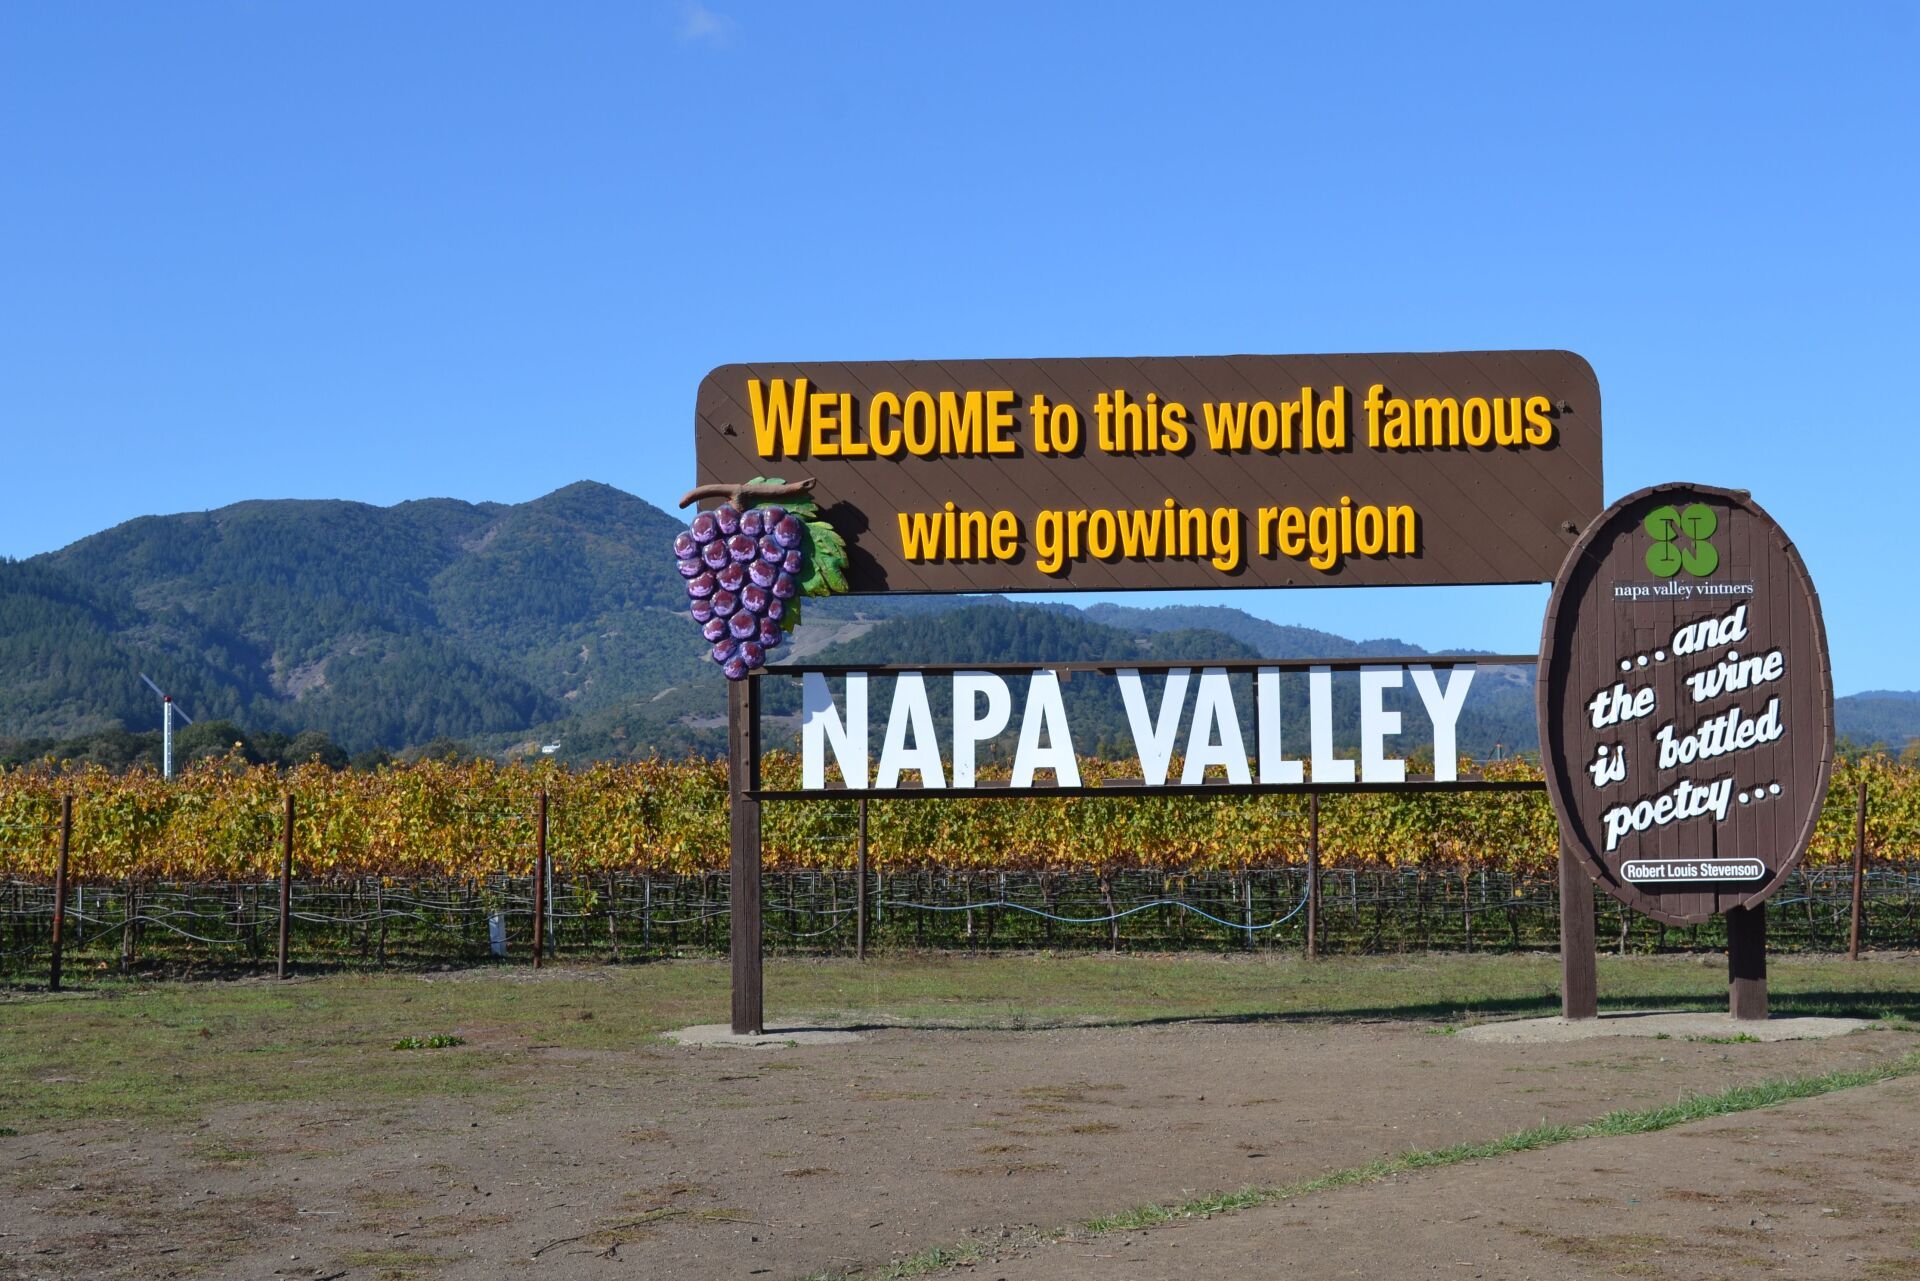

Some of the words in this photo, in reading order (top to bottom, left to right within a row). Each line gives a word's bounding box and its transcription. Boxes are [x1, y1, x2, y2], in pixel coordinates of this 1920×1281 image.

[748, 378, 1015, 457] WELCOME
[1030, 394, 1079, 453] to
[1095, 389, 1188, 452] this
[1203, 386, 1345, 450] world
[1364, 384, 1553, 448] famous
[898, 501, 1017, 560] wine
[1035, 498, 1239, 573] growing
[1258, 496, 1416, 571] region
[1614, 585, 1650, 600] napa
[1653, 581, 1693, 598] valley
[1696, 581, 1754, 595] vintners
[801, 670, 1083, 790] NAPA
[1115, 664, 1477, 786] VALLEY
[1590, 683, 1655, 728] the
[1687, 650, 1783, 702] wine
[1590, 745, 1626, 787] is
[1656, 698, 1783, 769] bottled
[1627, 864, 1665, 878] Robert
[1668, 864, 1697, 877] Louis
[1700, 862, 1759, 877] Stevenson
